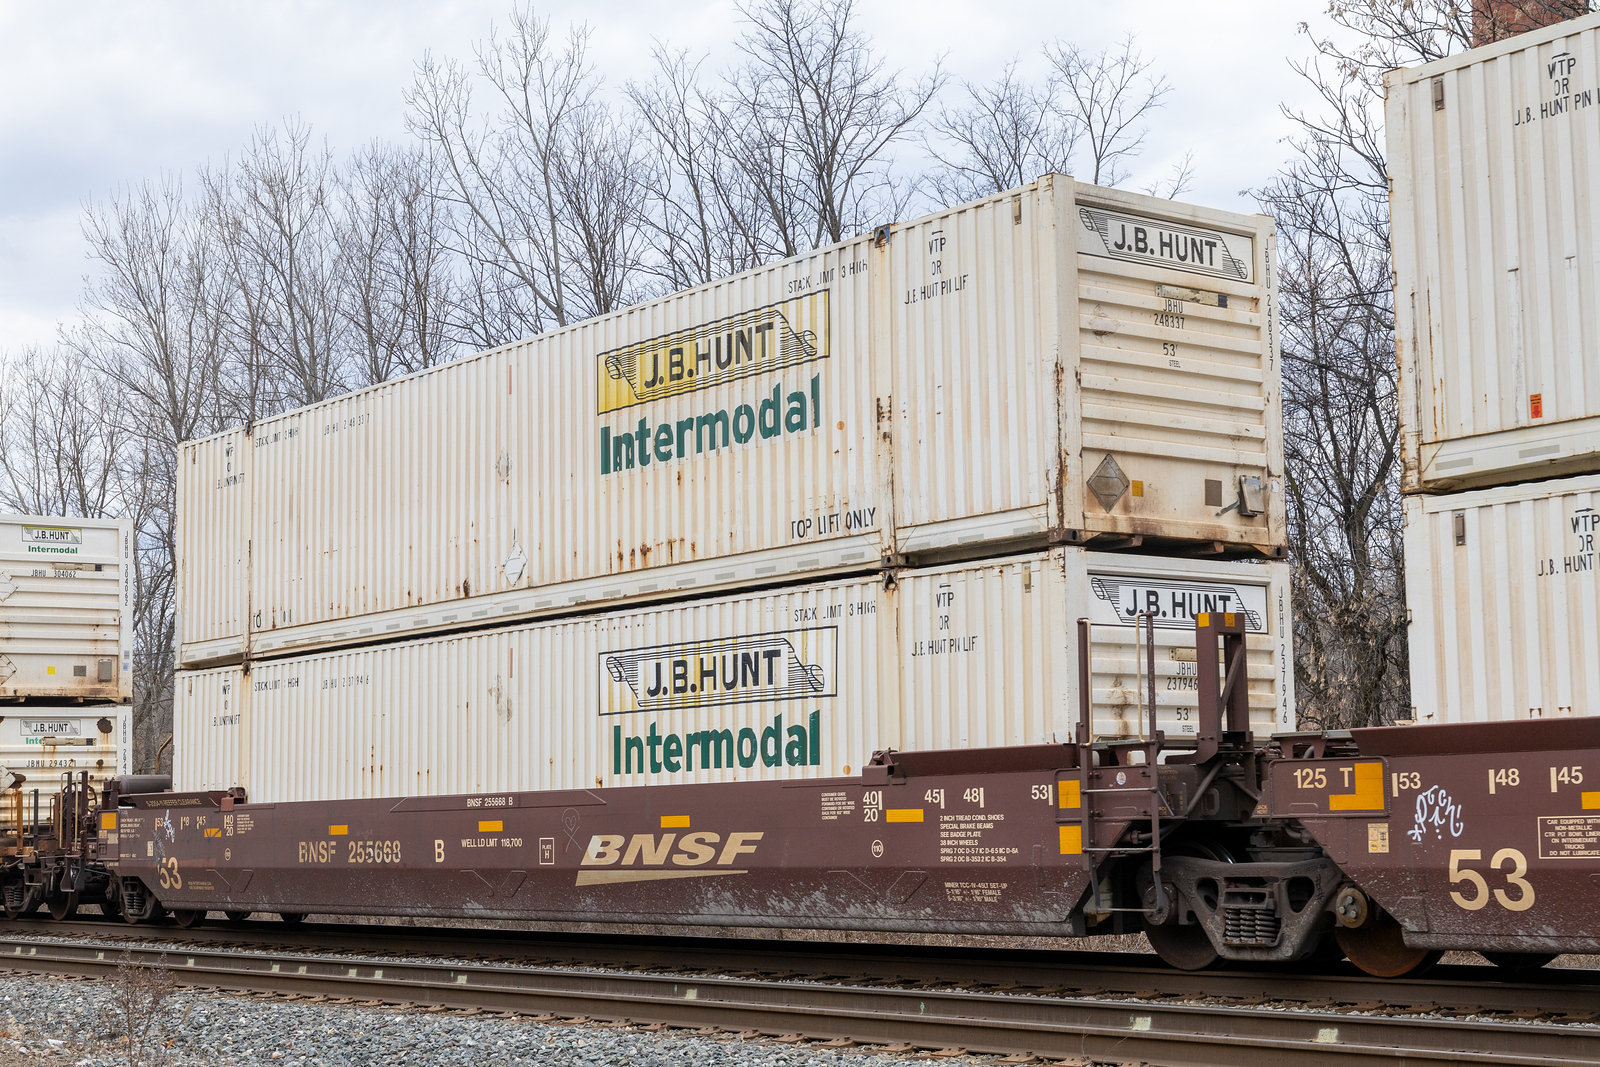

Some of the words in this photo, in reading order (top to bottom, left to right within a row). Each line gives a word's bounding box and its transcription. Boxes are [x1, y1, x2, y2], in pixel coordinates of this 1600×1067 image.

[1547, 57, 1576, 80] WTP
[1514, 106, 1536, 126] J.B.
[1540, 95, 1569, 119] HUNT
[1574, 89, 1592, 110] PIN
[1113, 224, 1155, 256] J.B.
[1159, 231, 1217, 266] HUNT
[841, 265, 846, 279] 3
[931, 259, 942, 276] OR
[1162, 299, 1184, 314] JBHU
[1153, 313, 1185, 330] 248337
[644, 347, 694, 389] J.B.
[695, 321, 774, 376] HUNT
[600, 371, 820, 476] Intermodal
[791, 518, 812, 539] TOP
[817, 513, 840, 535] LIFT
[845, 507, 877, 530] ONLY
[1570, 514, 1600, 534] WTP
[34, 530, 48, 540] J.B.
[49, 531, 70, 540] HUNT
[28, 545, 78, 554] Intermodal
[31, 569, 47, 577] JBHU
[54, 570, 77, 578] 304062
[1538, 558, 1559, 577] J.B.
[1563, 553, 1594, 574] HUNT
[849, 603, 854, 617] 3
[1125, 588, 1168, 618] J.B.
[1172, 591, 1231, 619] HUNT
[646, 659, 698, 698] J.B.
[699, 648, 782, 692] HUNT
[1176, 662, 1197, 676] JBHU
[1166, 677, 1199, 691] 237946
[1279, 643, 1288, 724] 237946
[33, 723, 47, 732] J.B.
[48, 723, 69, 733] HUNT
[613, 708, 821, 775] Intermodal
[1293, 767, 1327, 789] 125
[1339, 767, 1353, 788] T
[1398, 771, 1422, 790] 53
[1495, 768, 1520, 786] 48
[1557, 766, 1584, 785] 45
[863, 791, 878, 805] 40
[924, 788, 940, 803] 45
[963, 787, 980, 803] 48
[1031, 784, 1048, 800] 53
[466, 798, 483, 807] BNSF
[484, 797, 506, 807] 255668
[508, 796, 514, 806] B
[863, 808, 878, 822] 20
[298, 840, 337, 864] BNSF
[347, 840, 402, 864] 255668
[434, 839, 445, 863] B
[460, 838, 477, 848] WELL
[486, 838, 498, 848] LMT
[580, 831, 764, 866] BNSF
[544, 850, 550, 859] H
[157, 856, 182, 890] 53
[1449, 847, 1536, 912] 53
